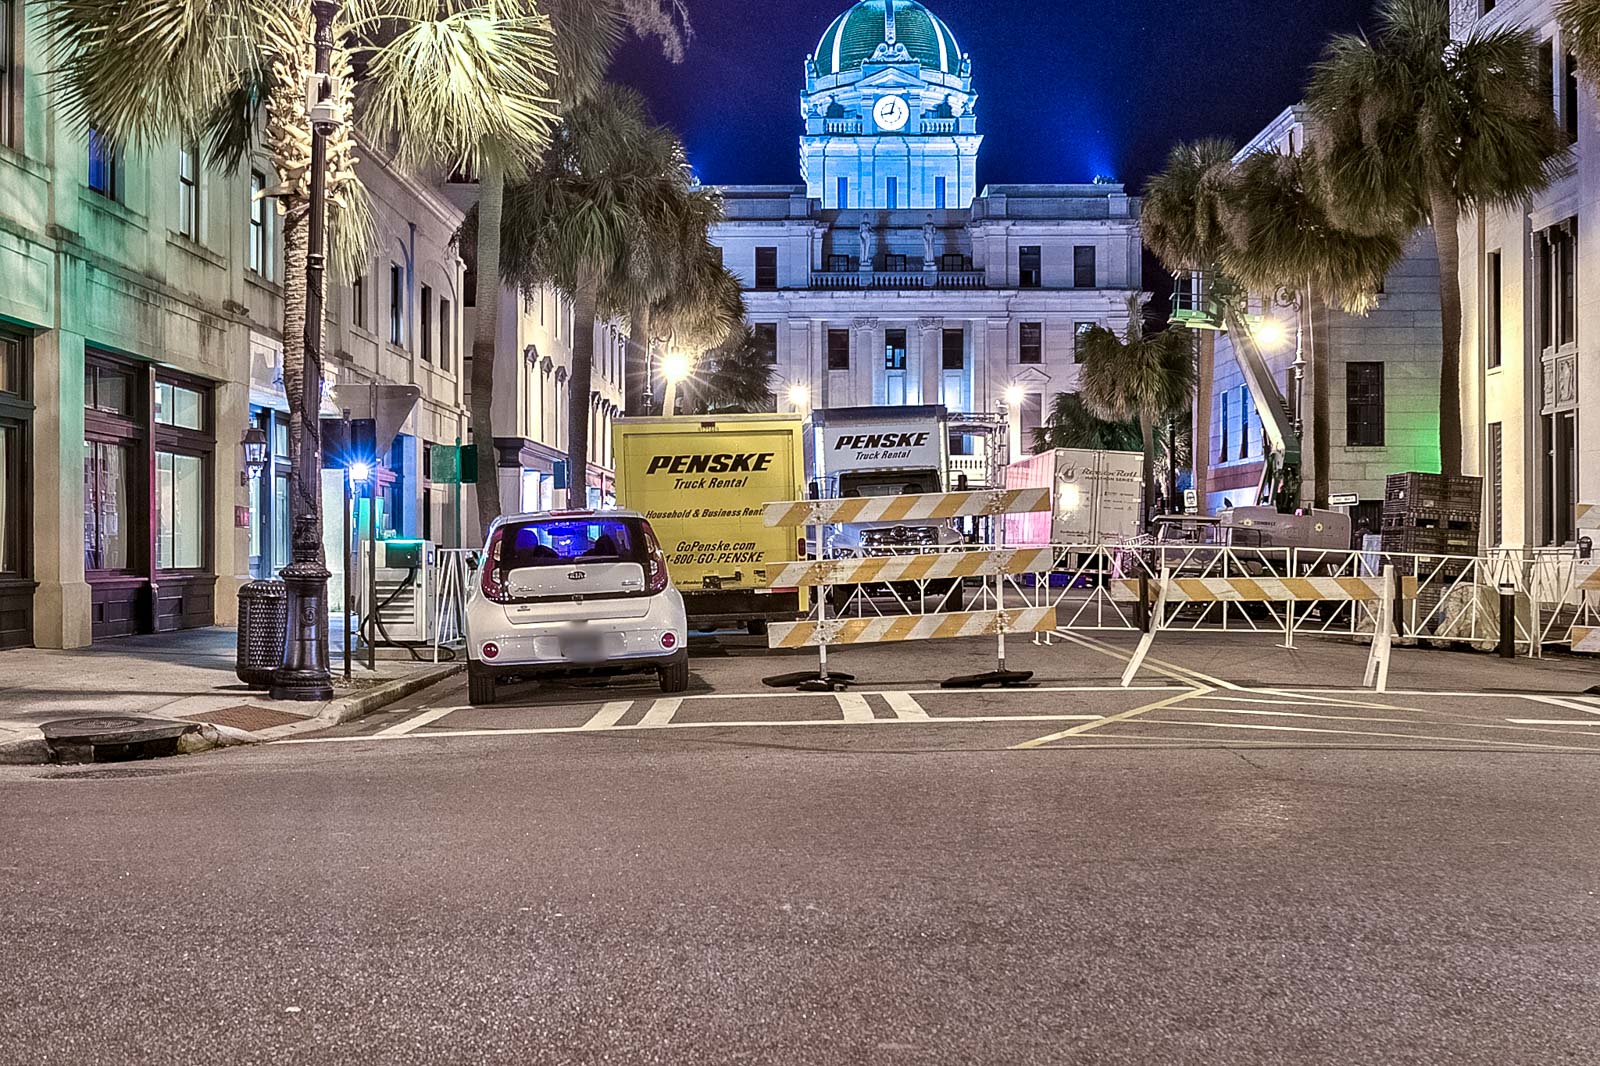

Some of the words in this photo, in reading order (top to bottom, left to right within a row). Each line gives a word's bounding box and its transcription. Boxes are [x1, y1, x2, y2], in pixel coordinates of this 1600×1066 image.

[834, 432, 930, 449] PENSKE
[855, 451, 880, 461] Truck
[881, 449, 912, 459] Rental
[646, 452, 775, 475] PENSKE
[673, 478, 706, 490] Truck
[707, 476, 748, 489] Rental
[645, 509, 691, 519] Household
[692, 508, 700, 518] &
[701, 507, 742, 518] Business
[742, 506, 764, 517] Rent
[676, 540, 756, 553] GoPenske.com
[665, 552, 764, 564] 1-800-GO-PENSKE
